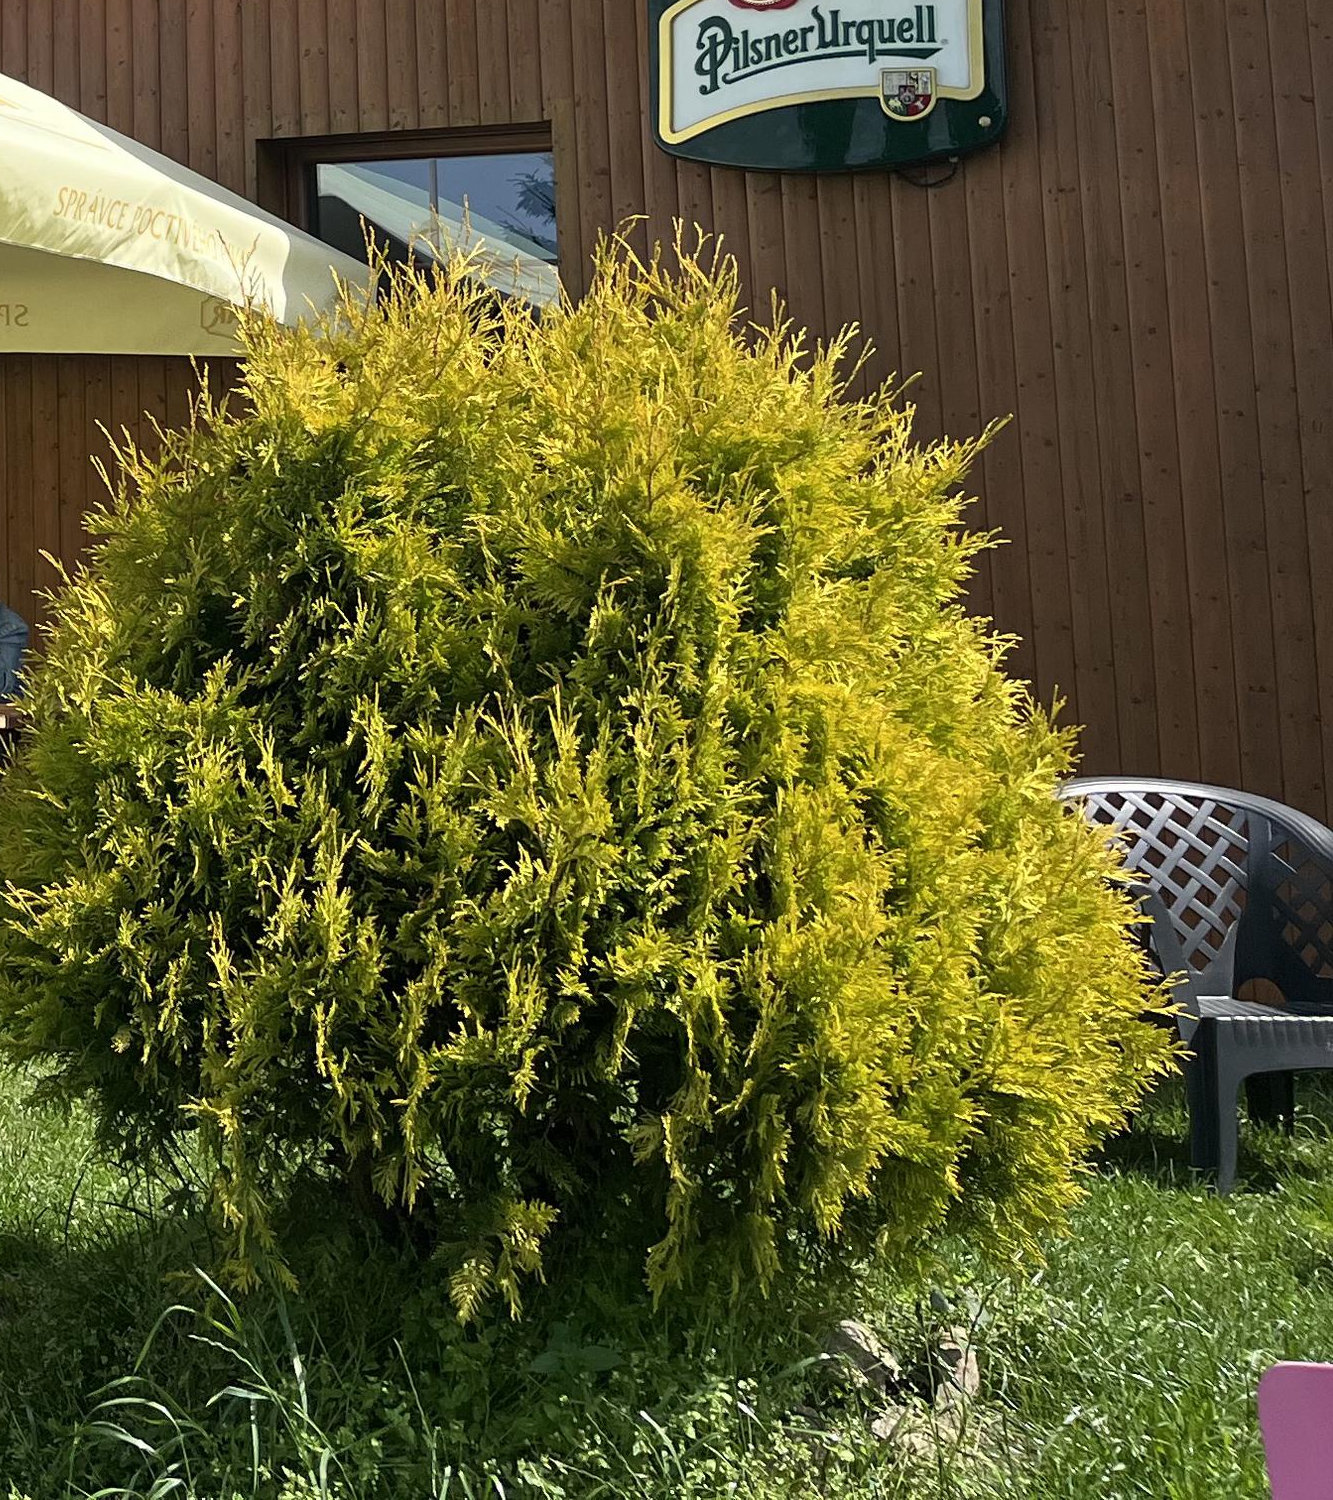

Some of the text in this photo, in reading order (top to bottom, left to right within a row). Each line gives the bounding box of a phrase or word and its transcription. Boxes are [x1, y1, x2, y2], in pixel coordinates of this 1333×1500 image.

[694, 4, 937, 95] Pilsner Urquell
[53, 186, 129, 231] SPRÁVCE
